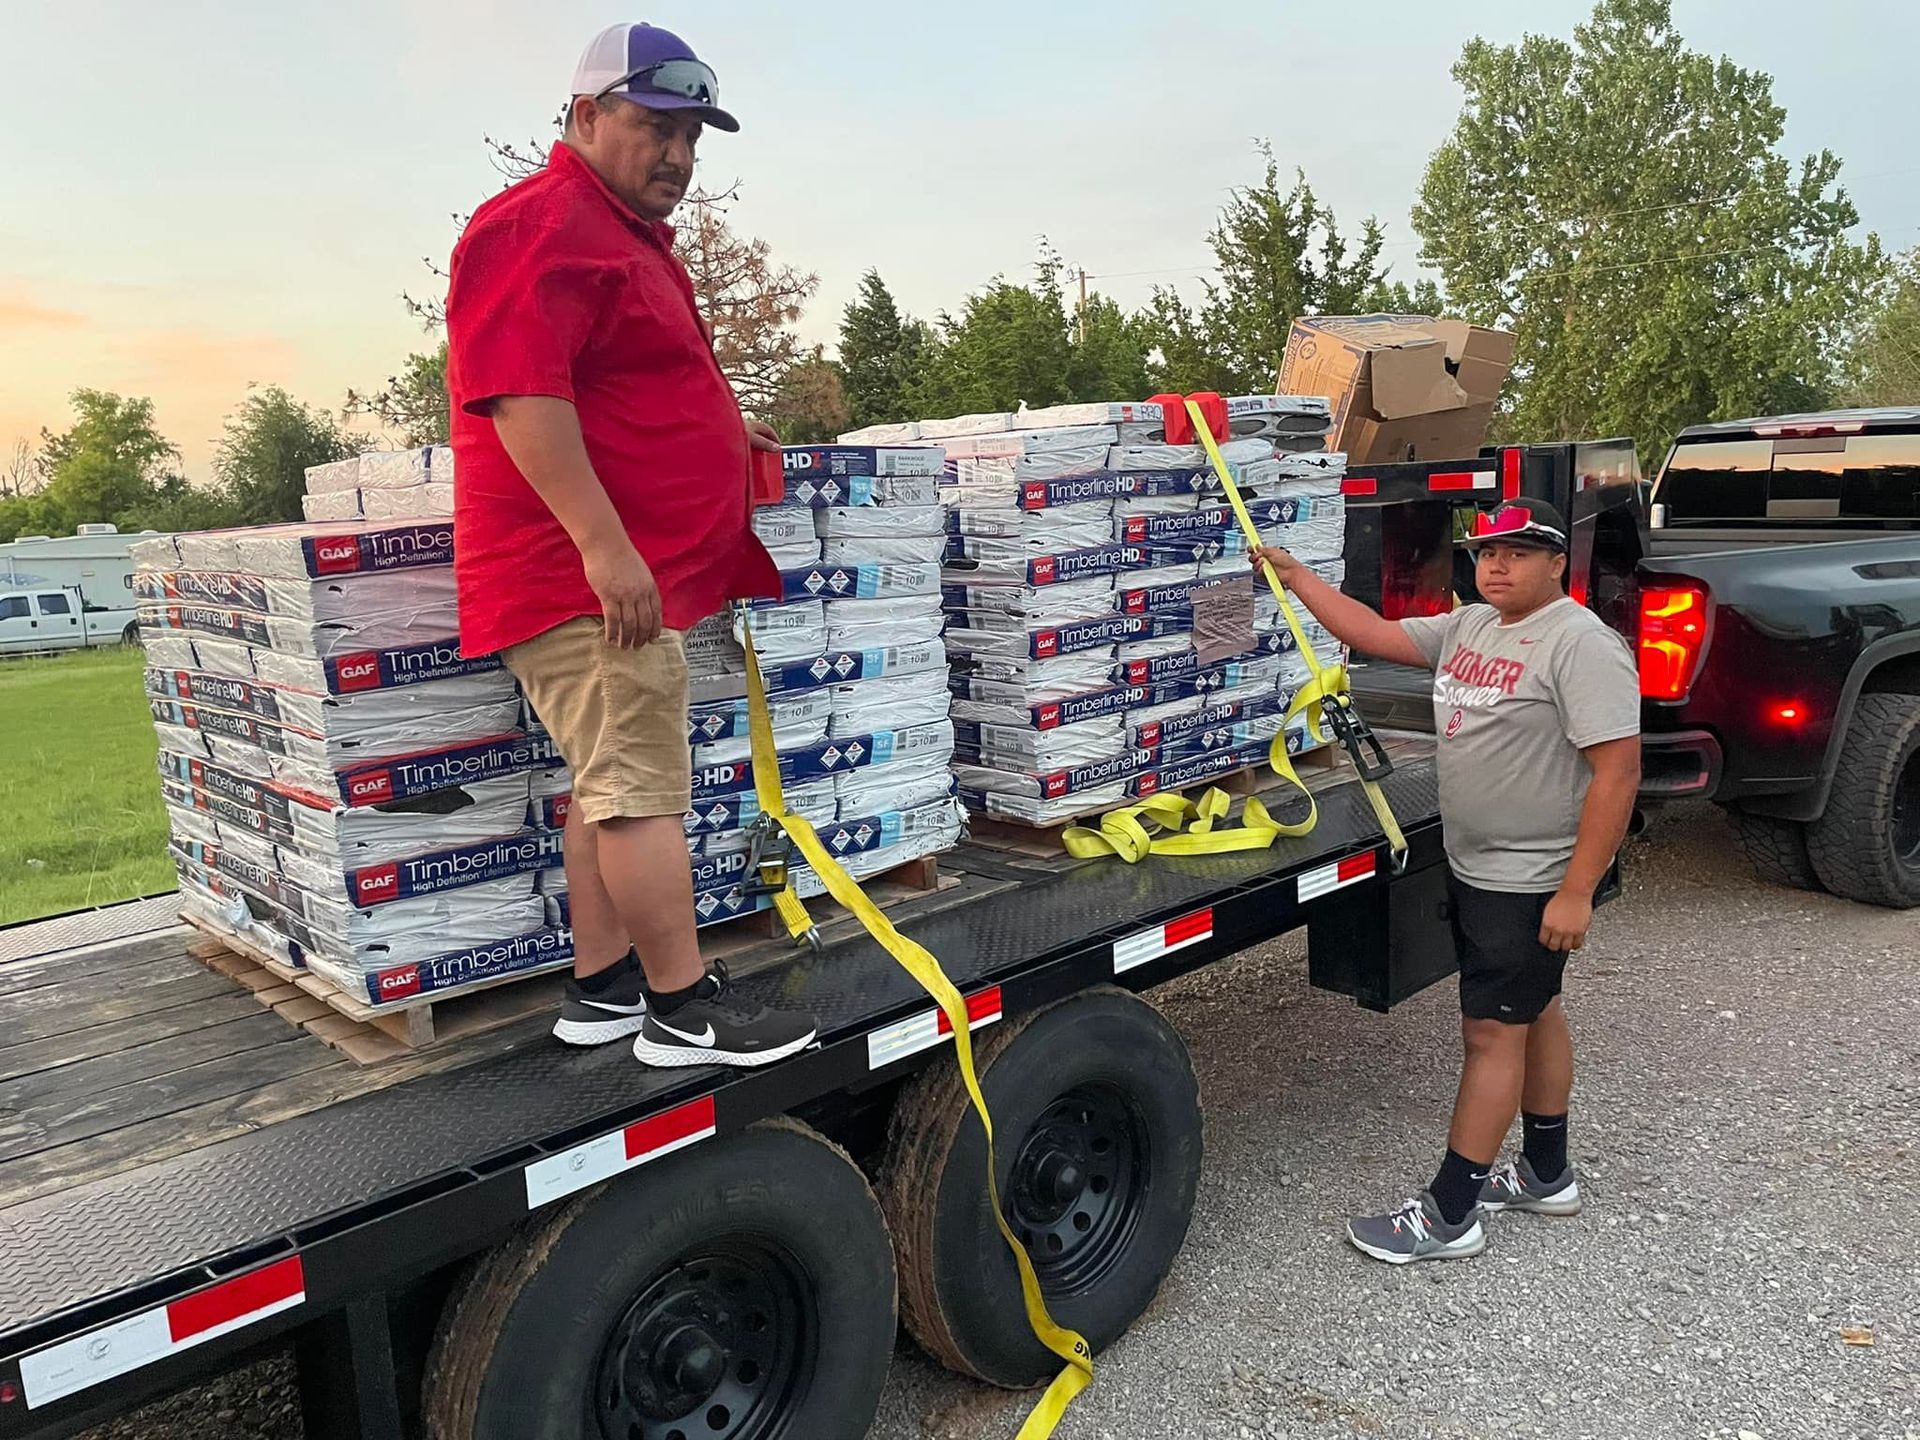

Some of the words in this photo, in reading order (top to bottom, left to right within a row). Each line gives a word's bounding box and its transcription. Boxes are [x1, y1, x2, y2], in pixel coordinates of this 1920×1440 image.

[1026, 490, 1044, 499] GAF
[1128, 524, 1143, 533] GAF
[319, 547, 356, 560] GAF
[375, 556, 398, 567] High
[1035, 564, 1053, 573] GAF
[1128, 597, 1144, 606] GAF
[1038, 638, 1055, 649] GAF
[340, 663, 377, 679] GAF
[394, 671, 417, 684] High
[419, 664, 463, 678] Definition
[1131, 667, 1146, 677] GAF
[1041, 711, 1058, 721] GAF
[1143, 729, 1158, 739] GAF
[352, 777, 388, 795] GAF
[406, 783, 429, 797] High
[431, 775, 477, 790] Definition
[1048, 780, 1066, 790] GAF
[360, 874, 395, 890] GAF
[412, 881, 434, 893] High
[436, 871, 482, 887] Definition
[434, 976, 456, 988] High
[537, 948, 572, 961] Shingles
[382, 972, 418, 990] GAF
